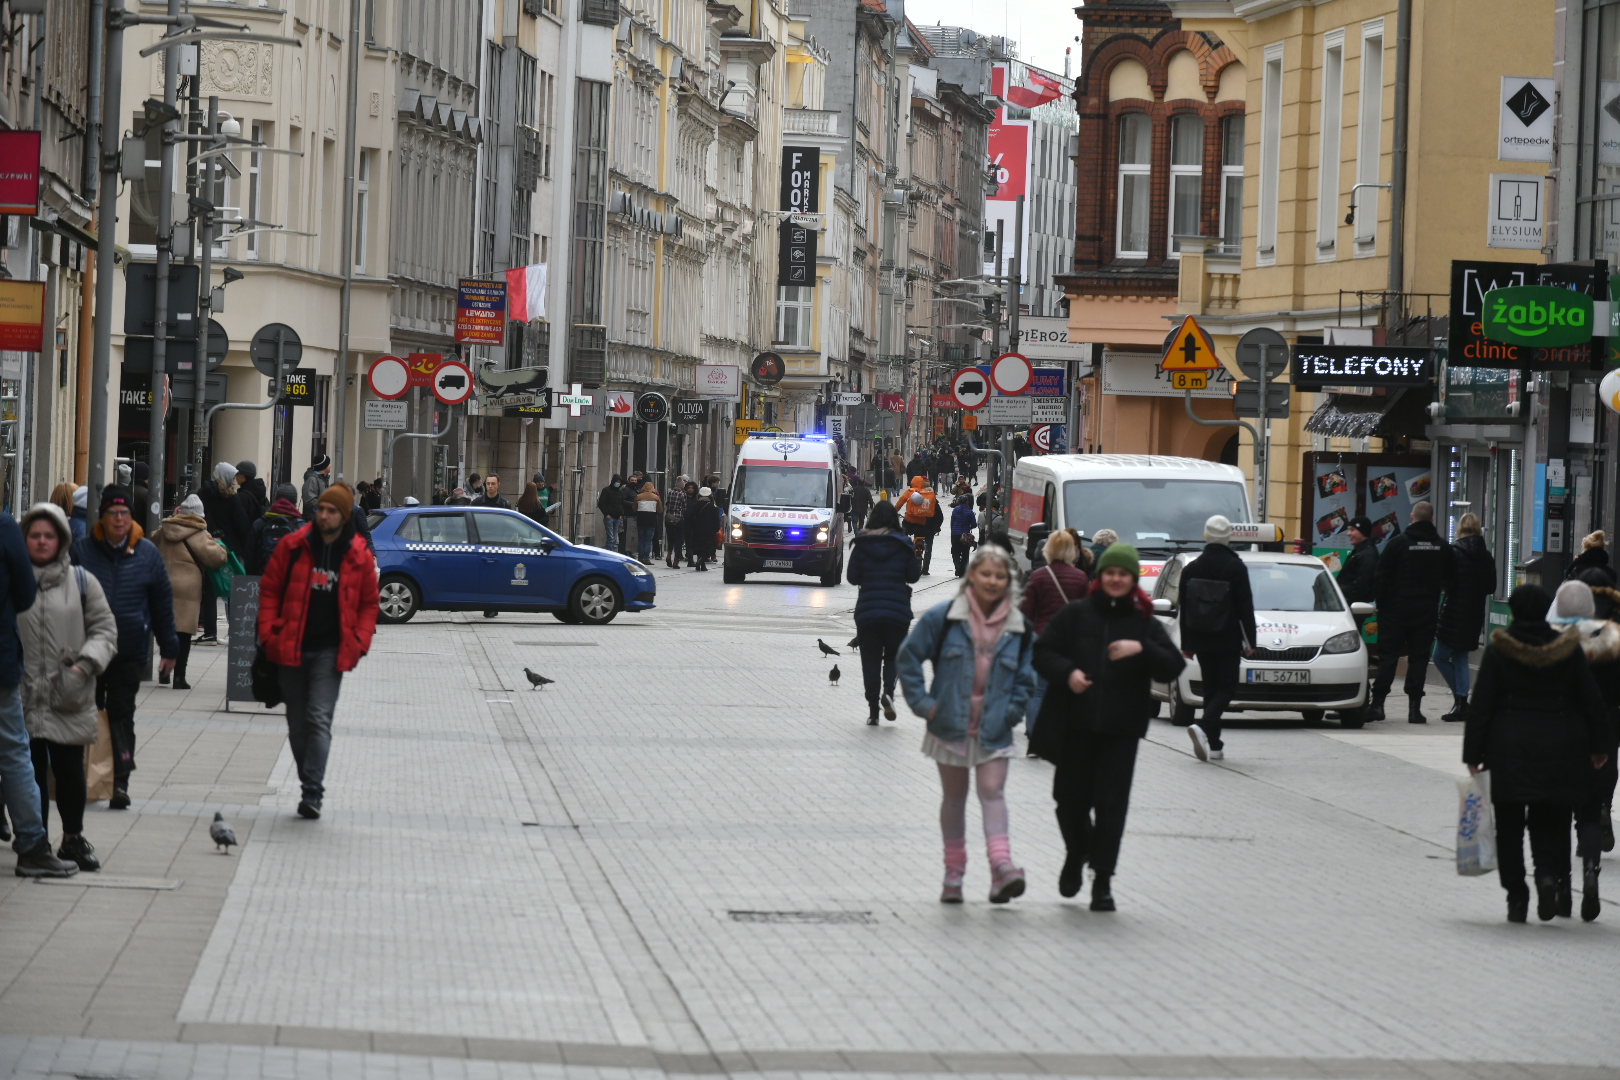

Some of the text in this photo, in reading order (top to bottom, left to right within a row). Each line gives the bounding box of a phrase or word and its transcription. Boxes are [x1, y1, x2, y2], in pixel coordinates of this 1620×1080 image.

[1492, 225, 1542, 237] ELYSIUM
[465, 309, 496, 318] LEWAND
[1492, 298, 1585, 327] żabka
[1017, 328, 1068, 343] PIEROŻ
[1463, 339, 1519, 360] clinic
[1298, 354, 1424, 376] TELEFONY
[286, 374, 307, 384] TAKE
[1178, 374, 1203, 387] 8 m
[120, 389, 146, 405] TAKE
[489, 395, 533, 407] WIELORYB
[677, 402, 704, 414] OLIVIA
[1257, 627, 1300, 635] ECURITY
[1254, 671, 1309, 683] WL 5671M
